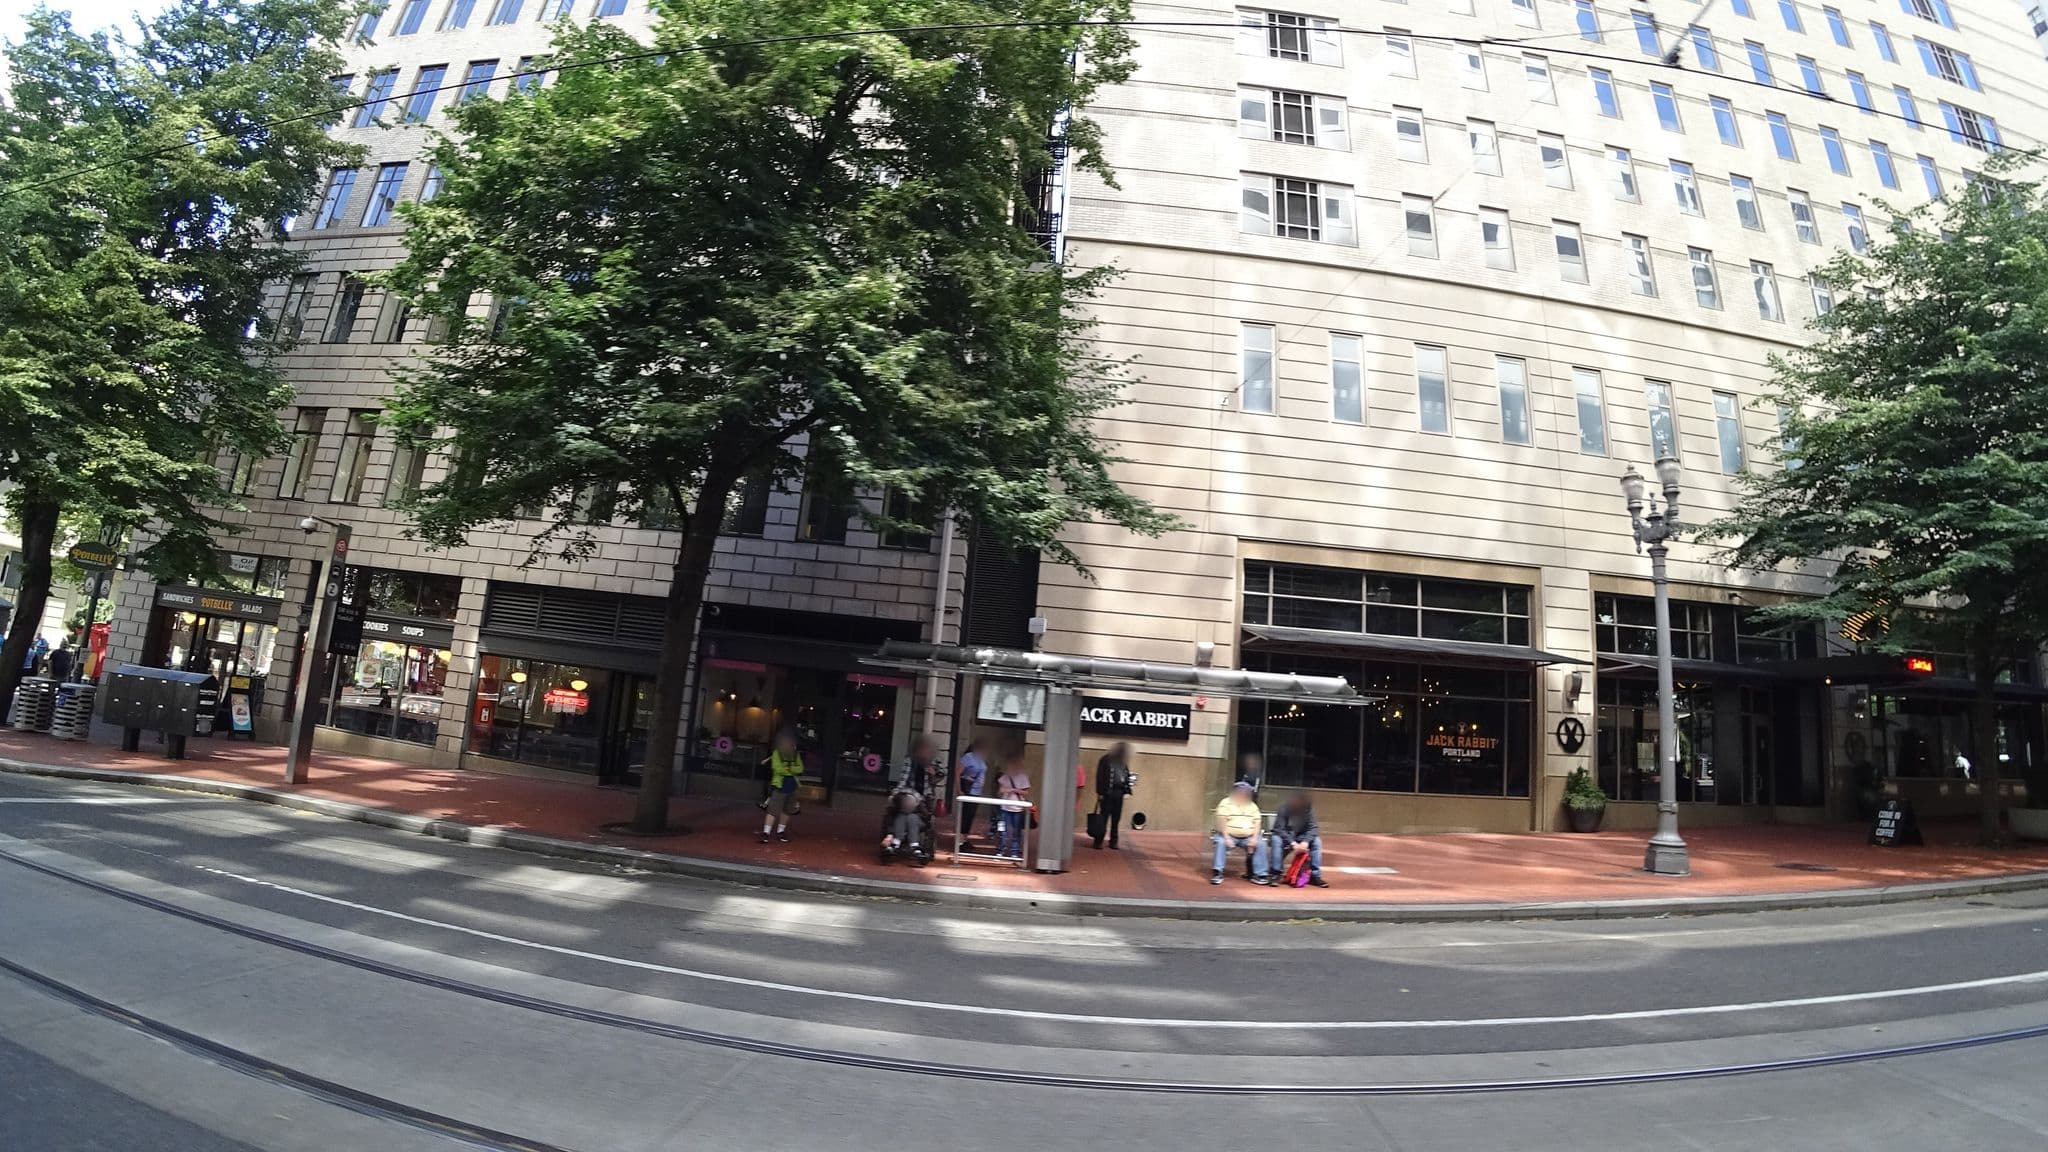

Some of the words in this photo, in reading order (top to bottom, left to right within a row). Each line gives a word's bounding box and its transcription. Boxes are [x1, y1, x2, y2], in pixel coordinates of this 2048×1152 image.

[162, 592, 194, 604] SANDWICHES
[201, 597, 234, 611] POTBELLY
[241, 603, 263, 614] SALADS
[401, 626, 424, 637] SOUPS
[1080, 707, 1115, 723] ACK
[1118, 709, 1187, 729] RABBIT
[1427, 735, 1455, 746] JACK
[1458, 736, 1496, 748] RABBIT
[1442, 748, 1480, 757] PORTLAND
